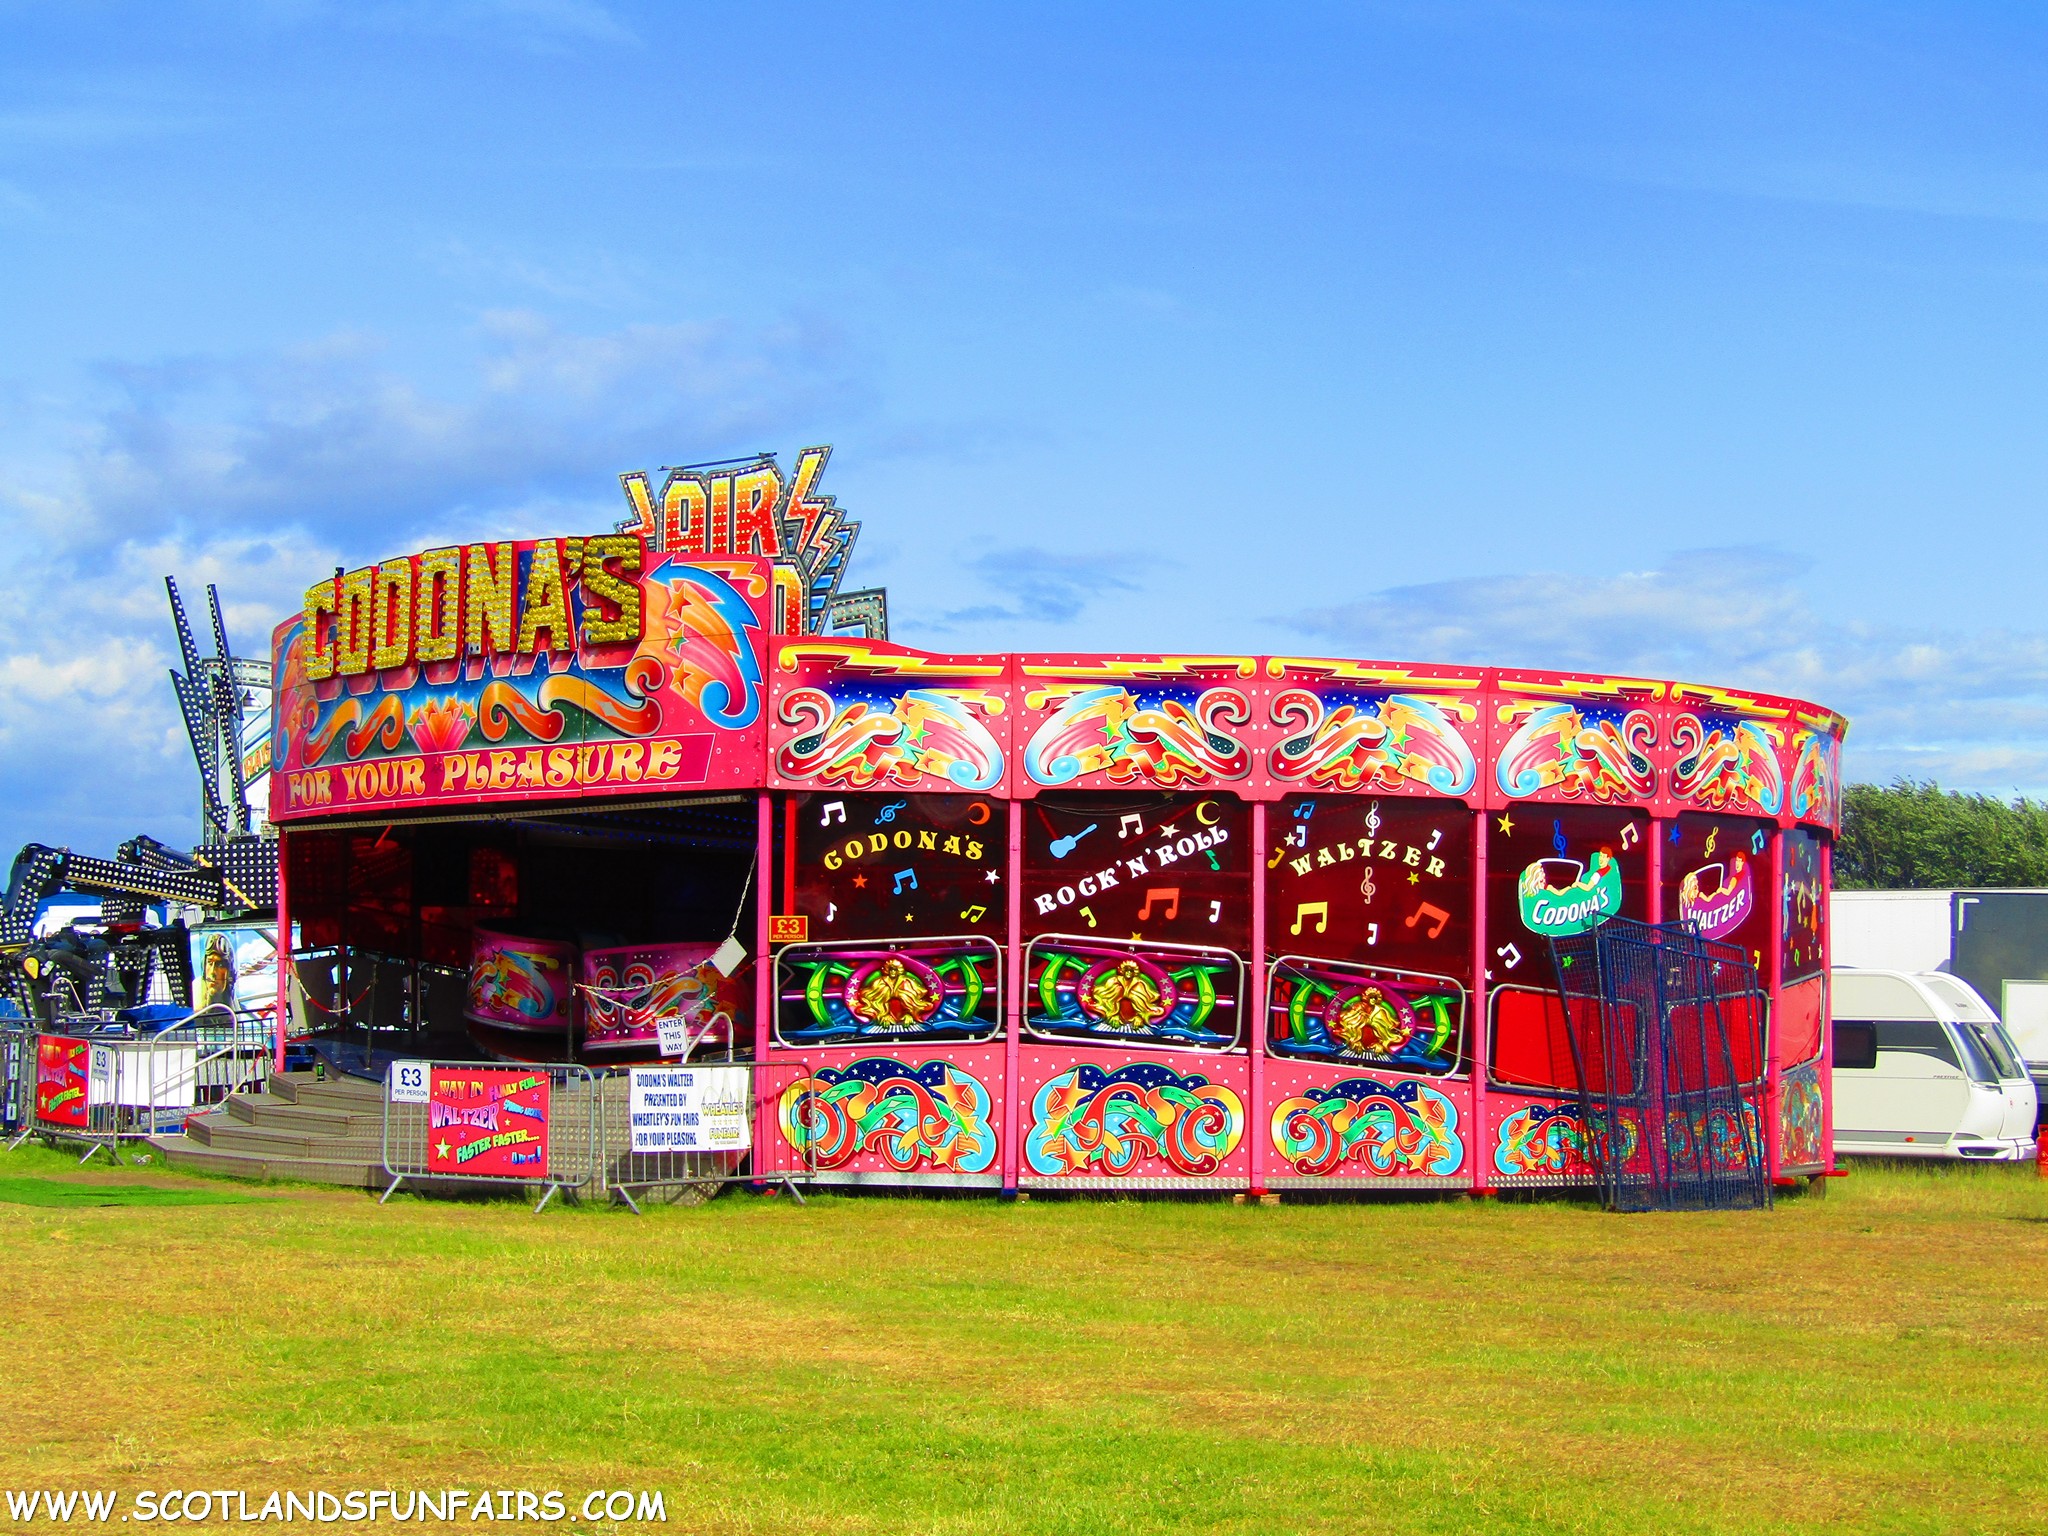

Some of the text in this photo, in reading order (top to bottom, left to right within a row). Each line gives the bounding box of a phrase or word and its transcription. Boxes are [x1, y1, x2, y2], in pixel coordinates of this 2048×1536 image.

[302, 535, 646, 681] CODONA'S
[288, 739, 683, 808] FOR YOUR PLEASURE
[823, 831, 986, 871] CODONA'S
[1289, 838, 1447, 878] WALTZER
[1532, 886, 1609, 926] CODONA'S
[1687, 889, 1745, 934] WALTZER
[777, 919, 800, 934] £3
[658, 1019, 682, 1029] ENTER
[664, 1031, 681, 1040] THIS
[666, 1043, 683, 1051] WAY
[96, 1051, 106, 1067] £3
[400, 1067, 422, 1087] £3
[667, 1074, 693, 1087] WALTZER
[406, 1089, 428, 1097] PERSON
[439, 1080, 484, 1099] WAY IN
[644, 1093, 687, 1106] PRESENTED BY
[431, 1100, 499, 1131] WALTZER
[632, 1113, 669, 1126] WHEATLEY'S
[682, 1113, 699, 1126] FAIRS
[635, 1132, 697, 1146] FOR YOUR PLEASURE
[456, 1137, 492, 1164] FASTER
